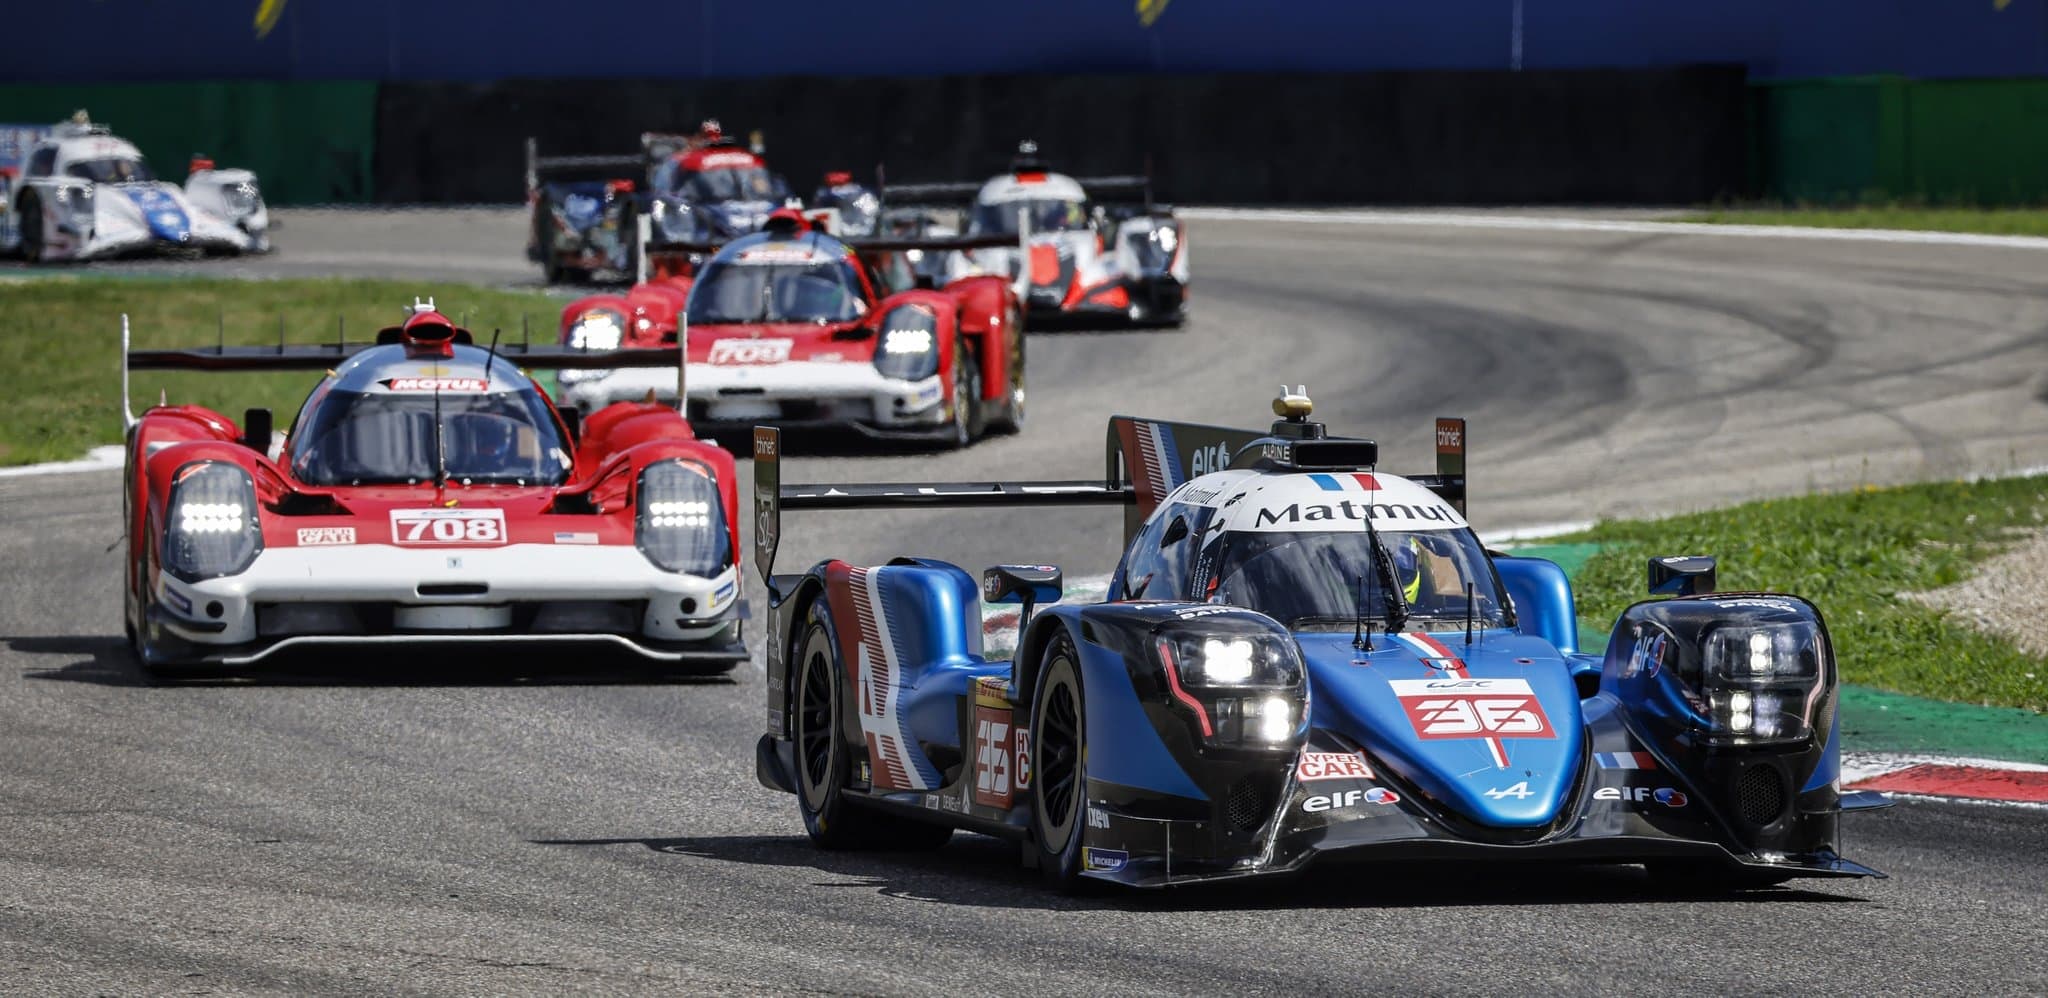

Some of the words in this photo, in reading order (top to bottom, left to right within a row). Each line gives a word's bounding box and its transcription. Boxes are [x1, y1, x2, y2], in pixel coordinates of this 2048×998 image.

[394, 380, 485, 391] MOTUL
[1262, 445, 1290, 461] ALPINE
[1255, 501, 1459, 529] Matmut
[398, 519, 499, 541] 708
[301, 535, 353, 544] CAR
[1415, 699, 1544, 733] 36
[1301, 762, 1368, 778] CAR
[1302, 790, 1362, 813] elf
[1593, 786, 1650, 801] elf
[1094, 856, 1122, 867] MICHELIN
